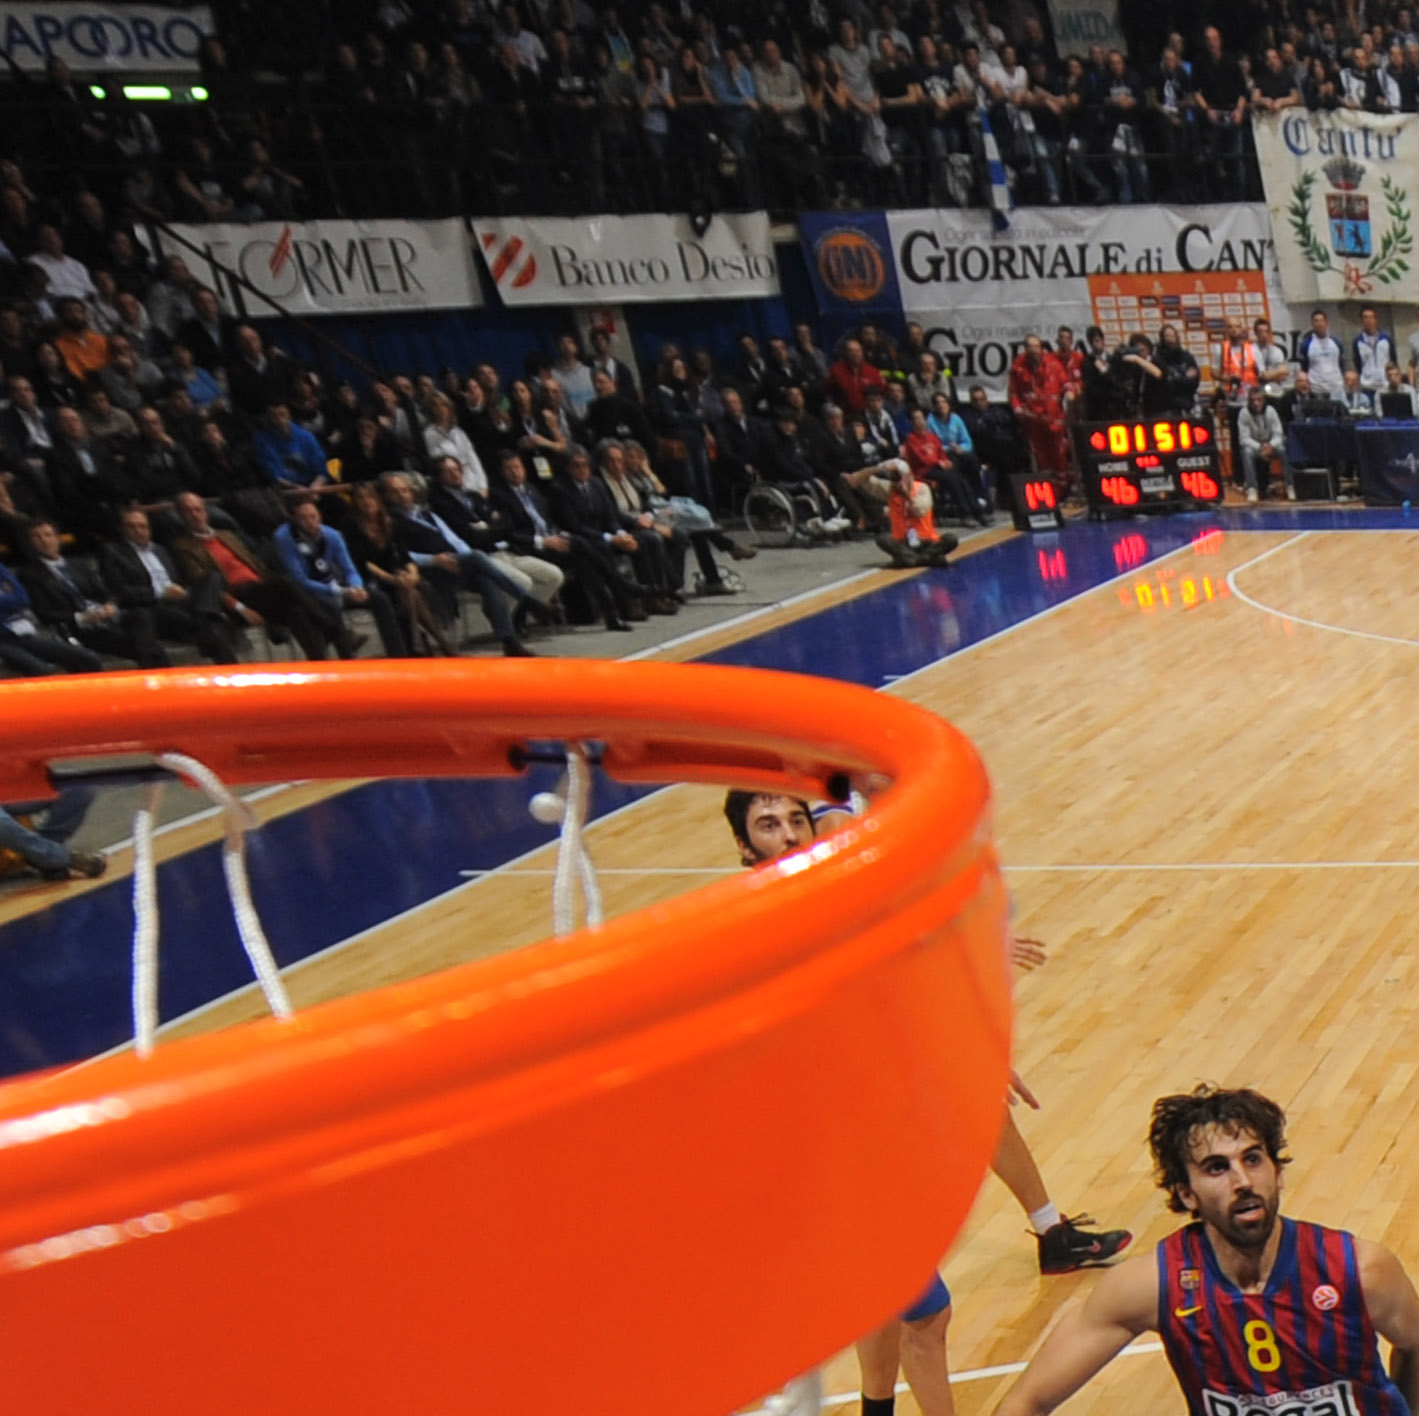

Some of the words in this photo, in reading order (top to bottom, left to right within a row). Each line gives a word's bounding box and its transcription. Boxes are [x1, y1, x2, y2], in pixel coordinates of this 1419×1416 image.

[549, 244, 669, 288] Banco
[675, 241, 776, 284] Desio
[901, 229, 1127, 285] GIORNALE
[1135, 247, 1163, 274] di
[1176, 456, 1211, 468] GUEST
[1243, 1319, 1281, 1373] 8
